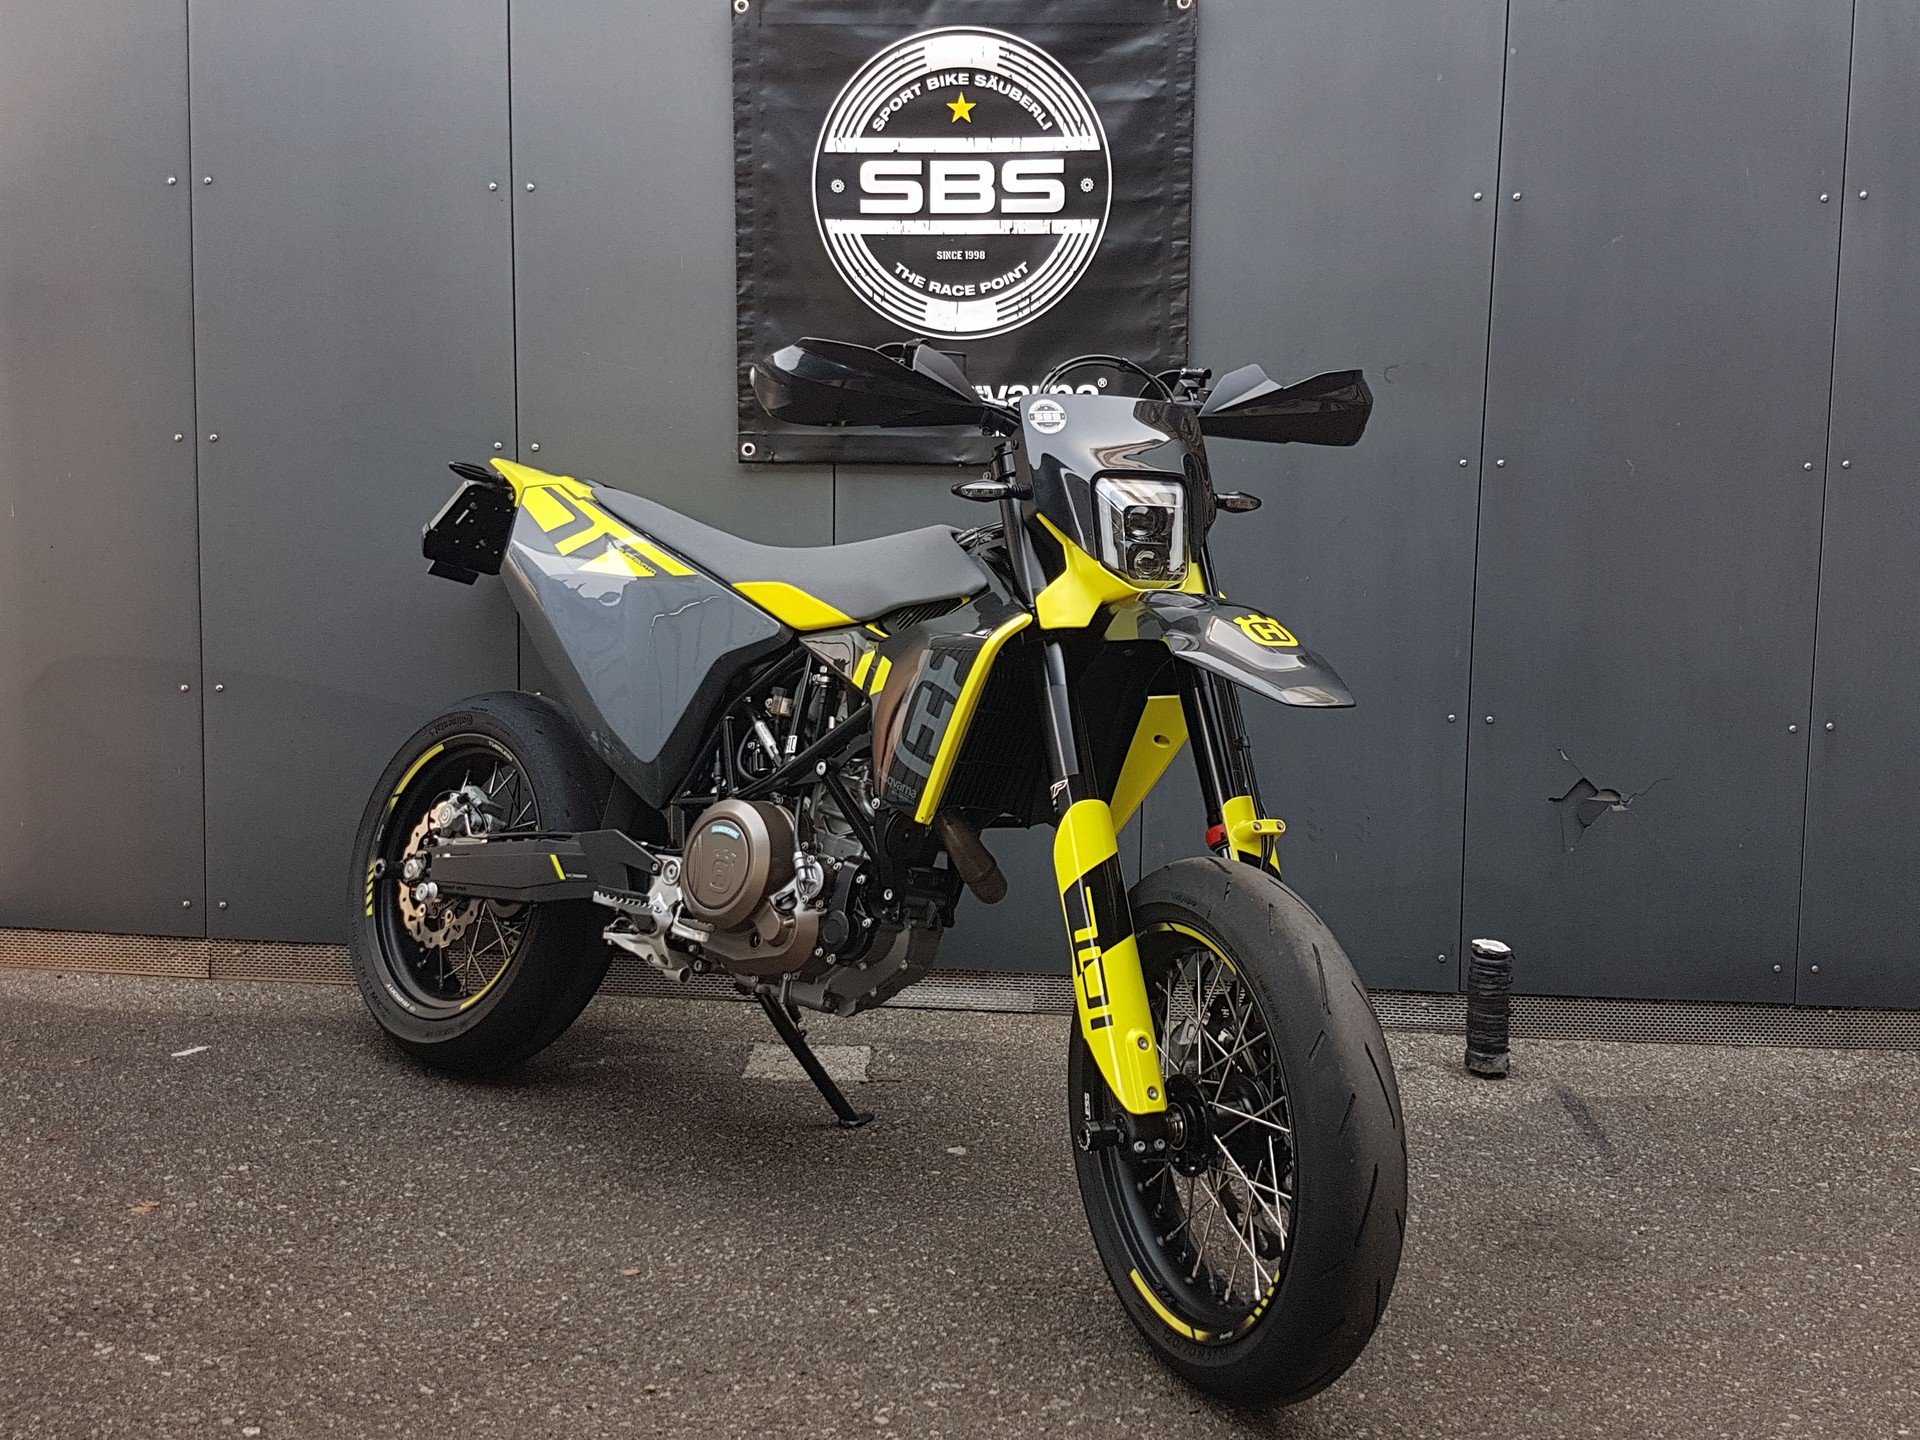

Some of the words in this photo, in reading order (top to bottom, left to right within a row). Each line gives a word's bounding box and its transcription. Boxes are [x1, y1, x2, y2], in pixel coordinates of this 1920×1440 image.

[871, 84, 922, 132] SPORT
[926, 73, 970, 91] BIKE
[974, 73, 1053, 131] SÄUBERLI
[858, 159, 1065, 214] SBS
[936, 250, 963, 260] SINCE
[965, 250, 986, 260] 1998
[894, 262, 927, 288] THE
[928, 283, 976, 297] RACE
[979, 261, 1030, 293] POINT
